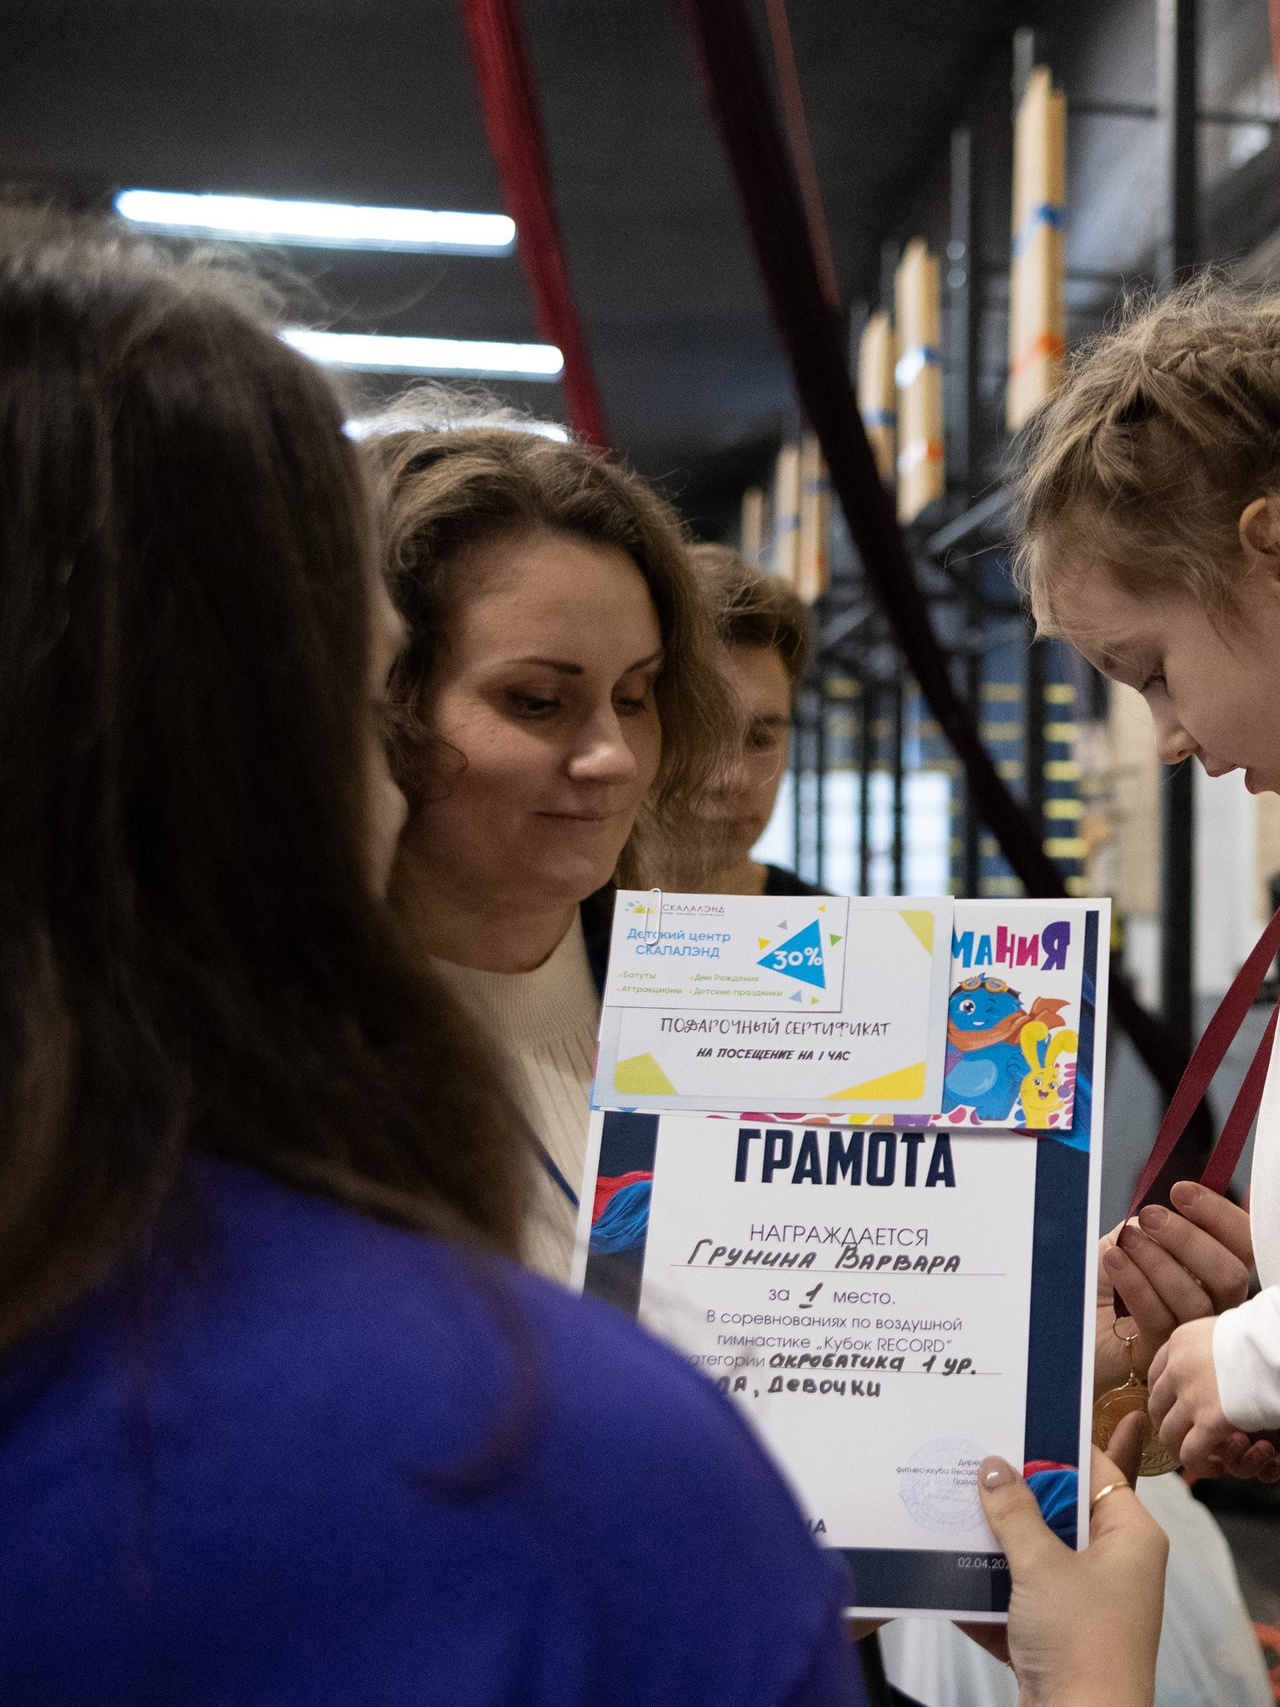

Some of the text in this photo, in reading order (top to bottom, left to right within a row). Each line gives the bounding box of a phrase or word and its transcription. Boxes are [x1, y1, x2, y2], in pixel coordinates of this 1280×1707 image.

[627, 928, 731, 943] Детский центр
[635, 944, 720, 959] СКАЛАЛЭНД
[772, 946, 823, 971] 30%
[623, 971, 656, 981] Батуты
[694, 974, 759, 983] Дни Рождения
[621, 985, 683, 995] Аттракционы
[694, 987, 783, 998] Детские праздники
[660, 1016, 891, 1037] ПОДАРОЧНЫЙ СЕРТИФИКАТ
[696, 1048, 713, 1058] НА
[717, 1048, 793, 1061] ПОСЕЩЕНИЕ
[797, 1050, 814, 1060] НА
[828, 1051, 852, 1061] ЧАС
[734, 1128, 956, 1188] ГРАМОТА
[750, 1223, 929, 1247] НАГРАЖДАЕТСЯ
[768, 1282, 896, 1305] за 1 место.
[706, 1310, 963, 1334] В соревнованиях по воздушной
[717, 1334, 811, 1349] гимнастике
[690, 1354, 765, 1370] атегории
[922, 1354, 937, 1374] 1
[958, 1458, 982, 1467] Дире
